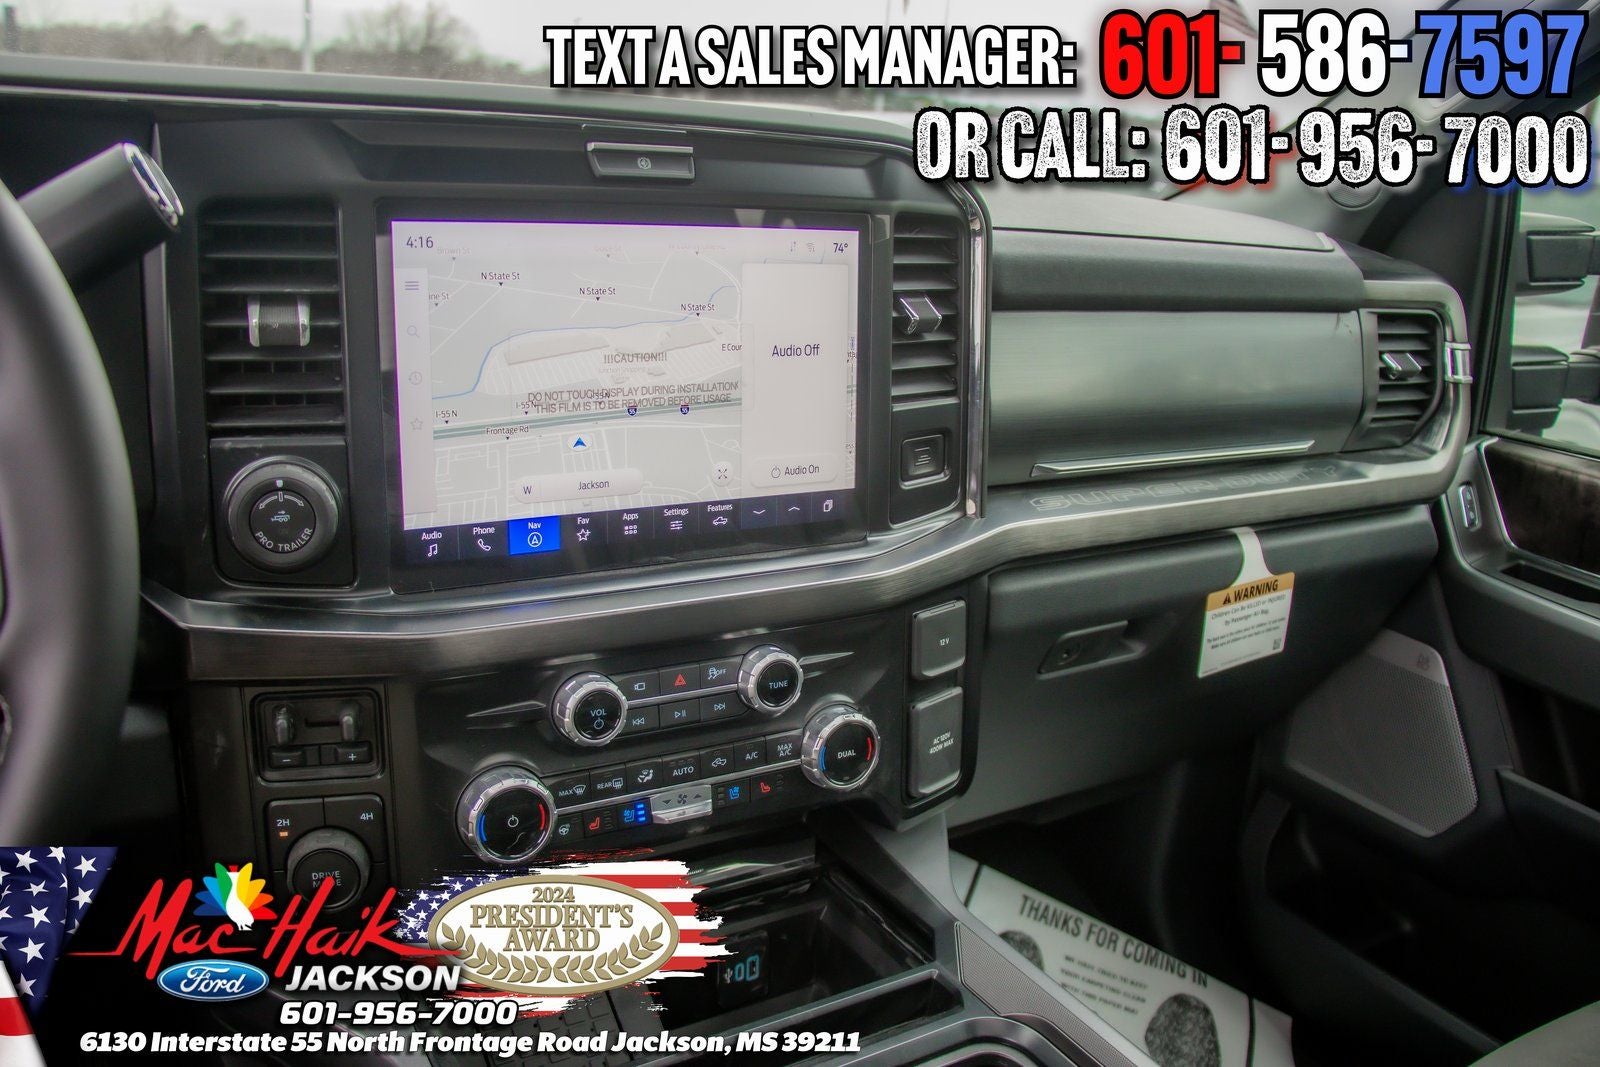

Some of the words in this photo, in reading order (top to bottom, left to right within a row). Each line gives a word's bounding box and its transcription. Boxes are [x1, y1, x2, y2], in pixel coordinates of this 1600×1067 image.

[405, 236, 434, 249] 4:16
[481, 272, 487, 280] N
[489, 272, 510, 280] State
[512, 272, 520, 280] St
[579, 287, 585, 295] N
[586, 287, 606, 295] State
[607, 287, 616, 295] St
[681, 303, 686, 311] N
[687, 303, 706, 311] State
[707, 303, 715, 311] St
[772, 344, 801, 357] Audio
[804, 343, 820, 356] Off
[528, 392, 542, 402] DO
[545, 391, 566, 402] NOT
[566, 388, 600, 400] TOUCH
[601, 386, 640, 398] DISPLAY
[641, 384, 675, 396] DURING
[535, 404, 556, 414] THIS
[559, 401, 580, 413] FILM
[583, 402, 591, 411] IS
[593, 400, 606, 410] TO
[608, 400, 620, 410] BE
[621, 397, 666, 408] REMOVED
[669, 395, 701, 405] BEFORE
[703, 393, 731, 404] USAGE
[435, 410, 451, 418] I-55
[486, 427, 518, 436] Frontage
[784, 466, 806, 476] Audio
[808, 464, 820, 474] On
[578, 479, 610, 490] Jackson
[523, 486, 532, 495] W
[663, 507, 689, 517] Settings
[707, 503, 733, 513] Features
[577, 516, 590, 525] Fav
[623, 512, 639, 521] Apps
[528, 521, 542, 530] Nav
[473, 526, 495, 535] Phone
[255, 531, 274, 549] PRO
[278, 527, 313, 552] TRAILER
[421, 531, 443, 540] Audio
[1234, 579, 1279, 602] WARNING
[715, 668, 727, 676] OFF
[768, 680, 789, 689] TUNE
[590, 708, 607, 717] VOL
[777, 743, 793, 752] MAX
[745, 751, 759, 761] A/C
[779, 750, 792, 758] A/C
[837, 749, 857, 759] DUAL
[672, 766, 694, 776] AUTO
[597, 781, 612, 790] REAR
[558, 789, 574, 797] MAX
[360, 812, 374, 821] 4H
[276, 819, 290, 827] 2H
[313, 879, 342, 888] ME
[1017, 894, 1084, 938] THANKS
[1086, 920, 1120, 953] FOR
[1122, 937, 1187, 980] COMING
[1191, 968, 1209, 989] IN
